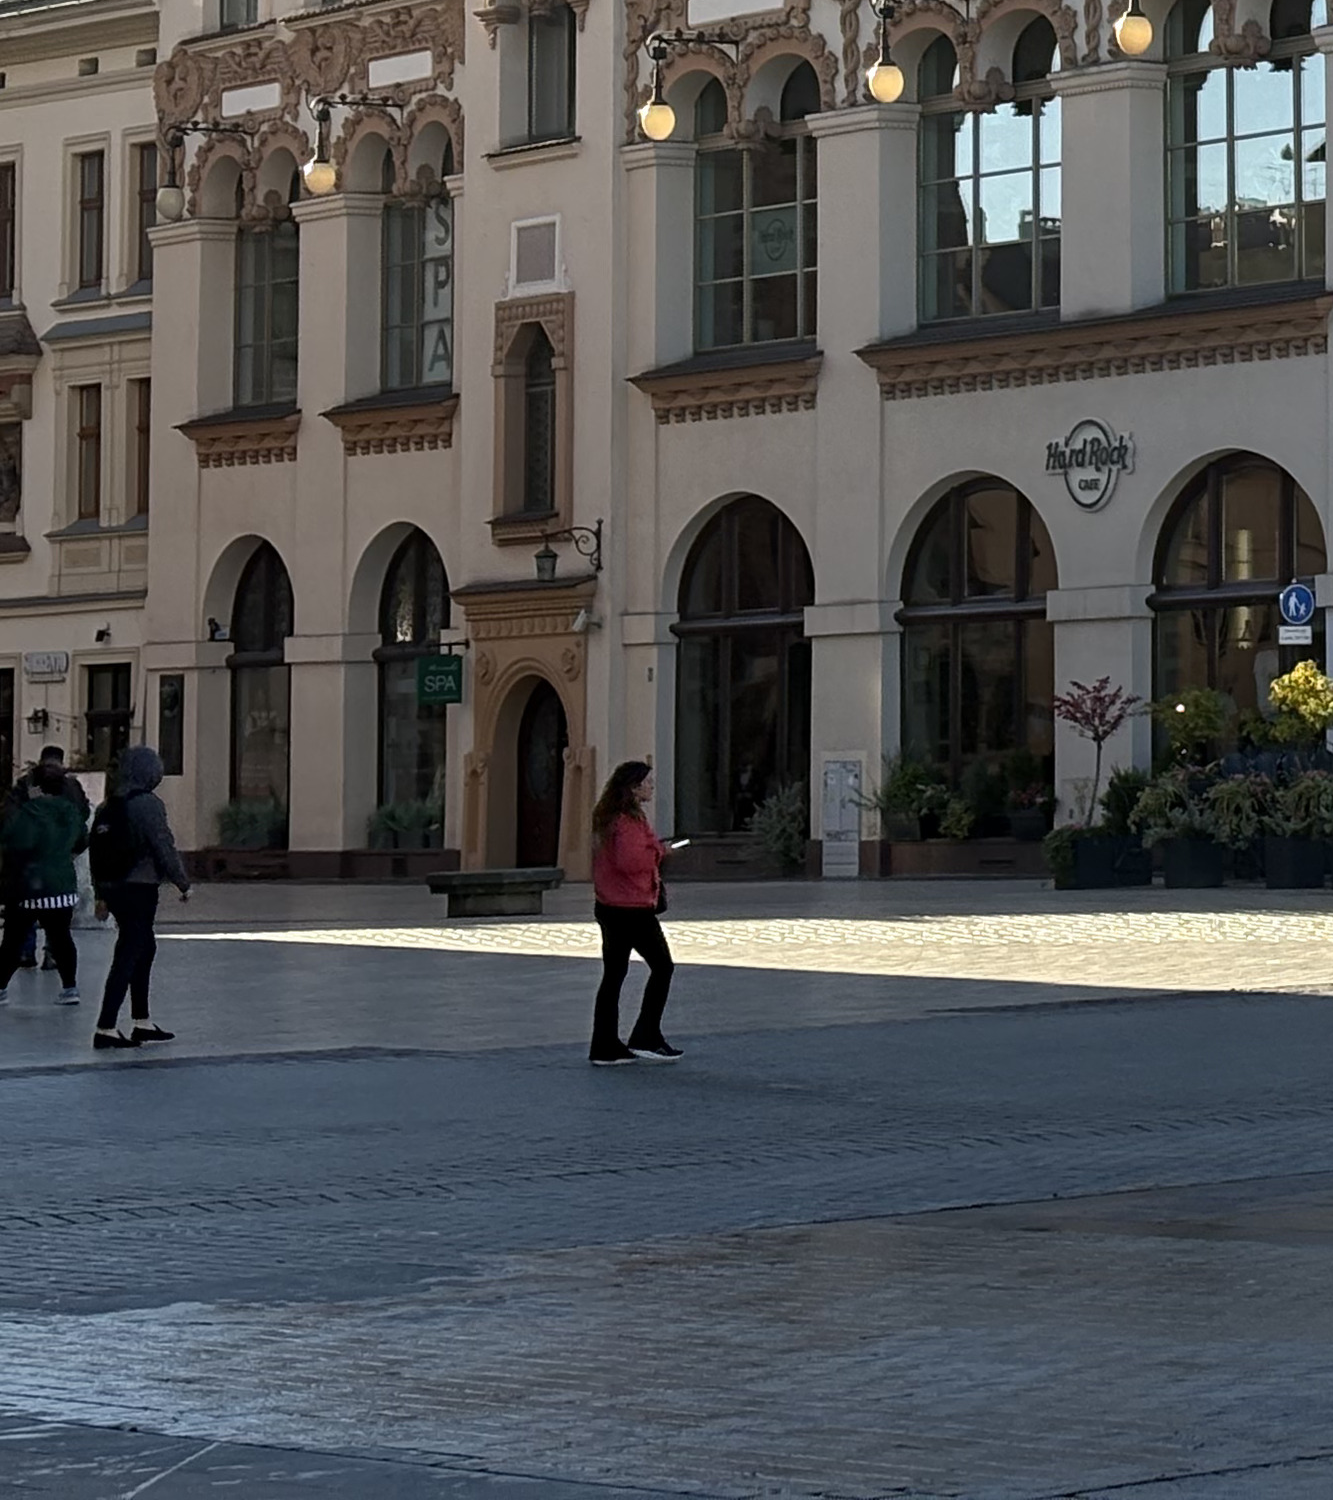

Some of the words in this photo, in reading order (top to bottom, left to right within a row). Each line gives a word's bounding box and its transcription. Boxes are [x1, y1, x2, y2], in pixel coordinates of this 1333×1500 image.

[428, 199, 452, 372] SPA
[1045, 437, 1088, 472] Hard
[1088, 434, 1129, 474] Rock
[1078, 478, 1101, 491] CAFE
[424, 675, 457, 693] SPA
